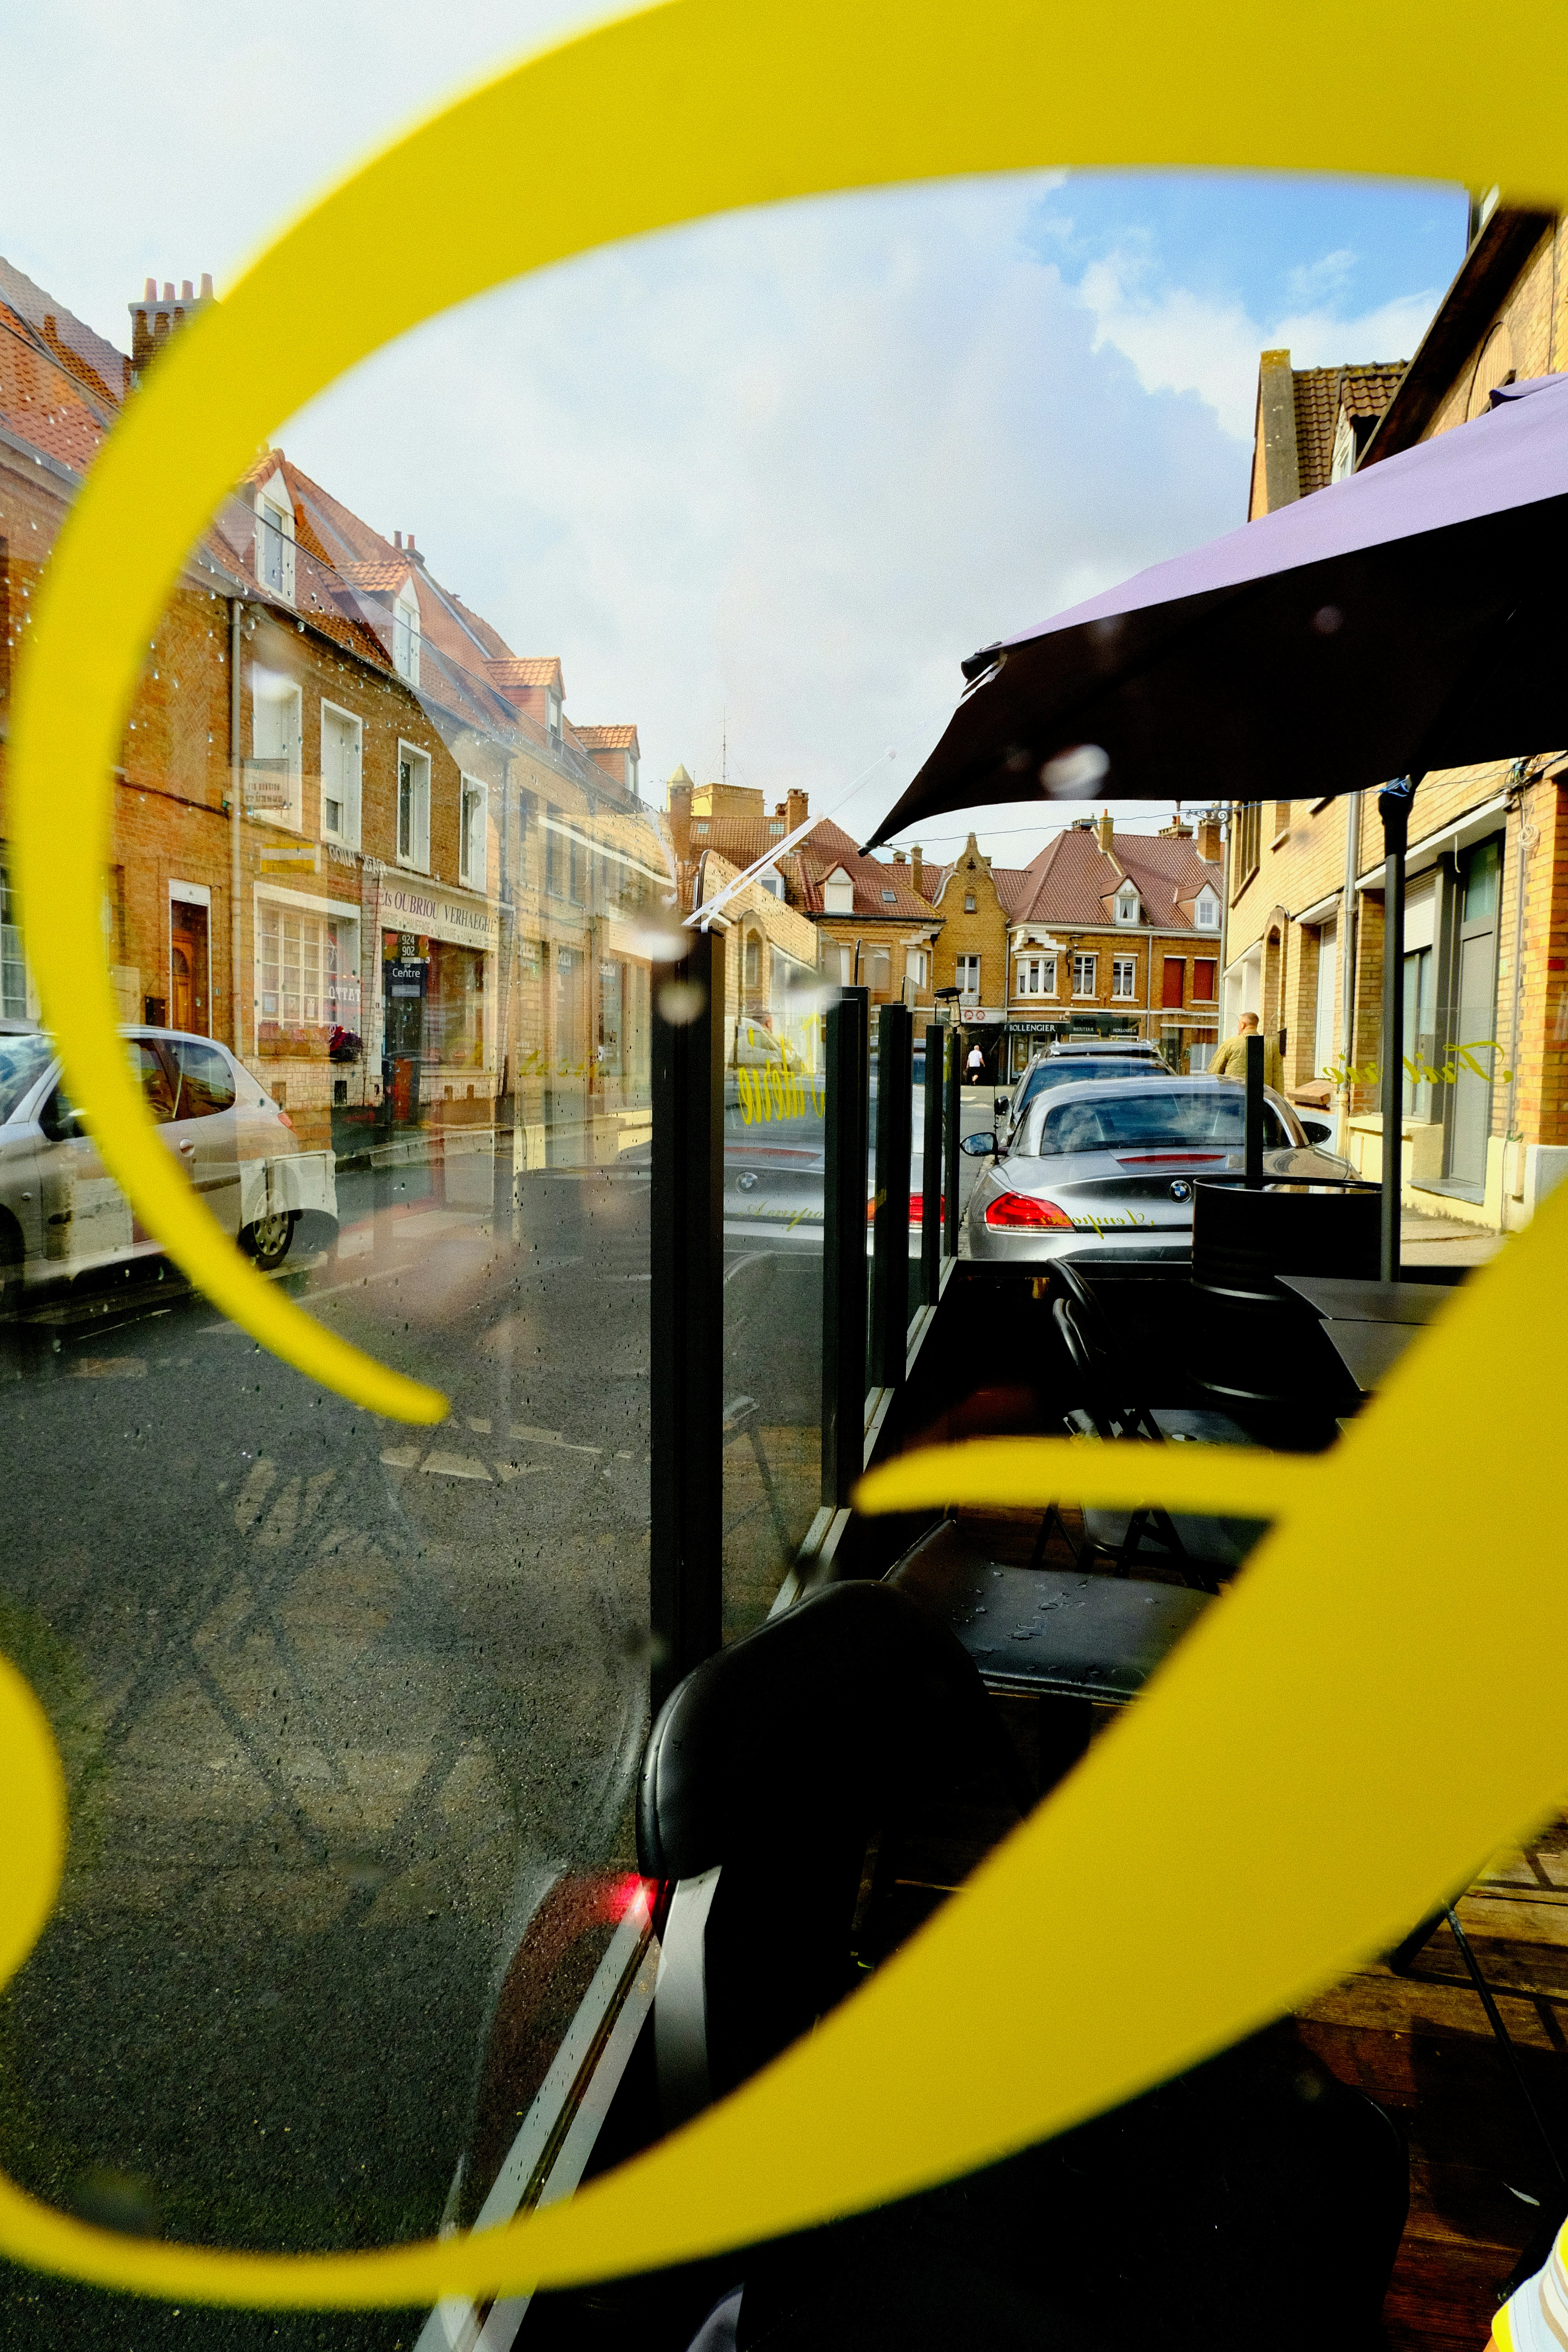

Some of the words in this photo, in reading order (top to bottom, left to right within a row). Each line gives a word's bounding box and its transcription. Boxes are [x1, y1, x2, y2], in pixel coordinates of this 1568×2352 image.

[394, 891, 439, 920] OUBRIOU
[444, 905, 495, 934] VERHAEGHE
[402, 935, 415, 945] 924
[402, 946, 415, 956] 902
[392, 968, 421, 978] Centre
